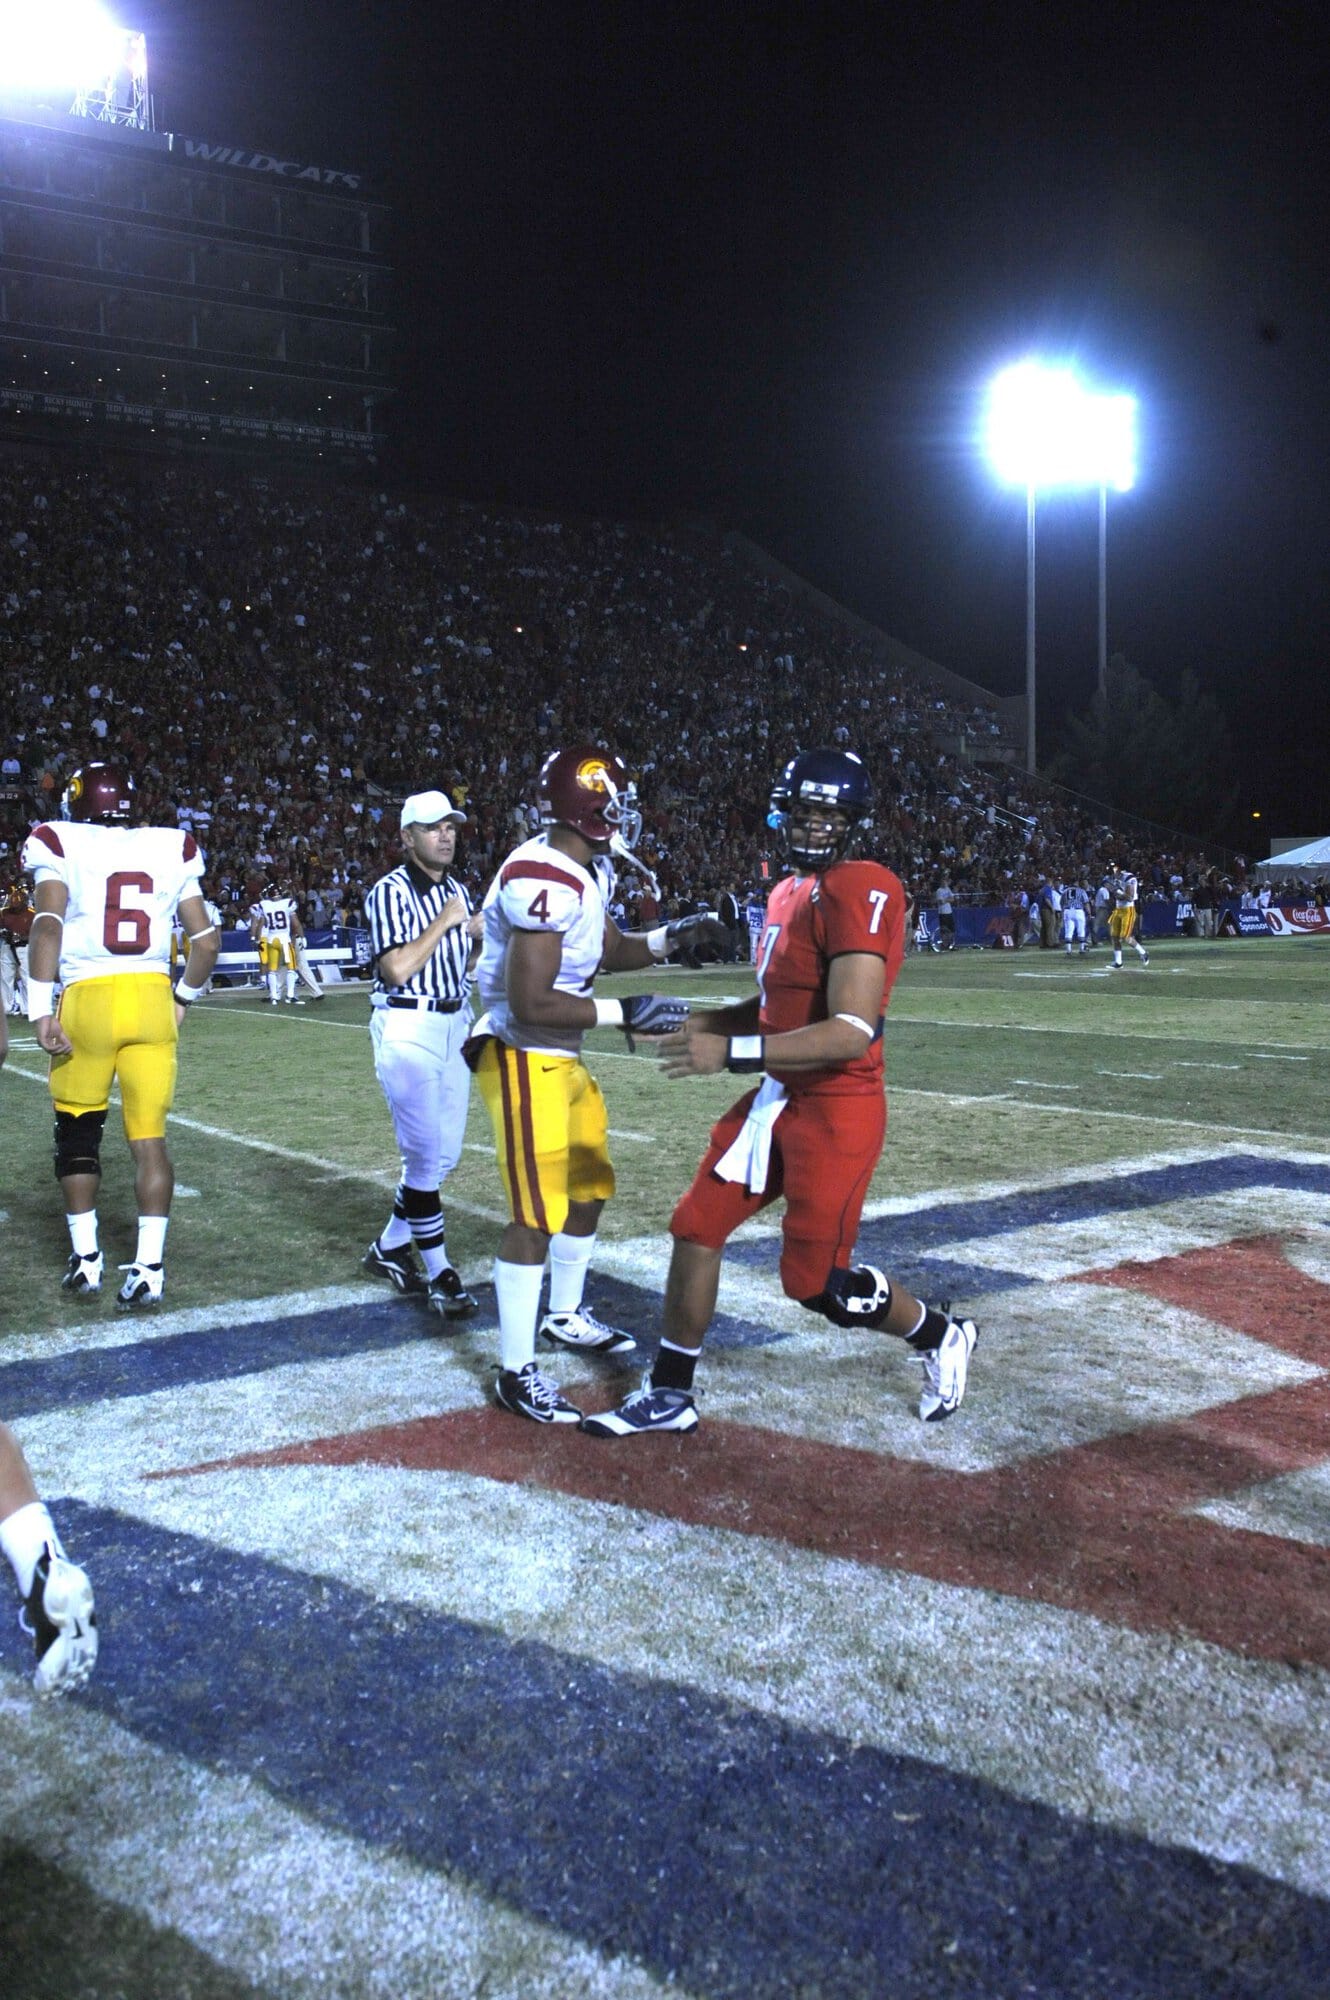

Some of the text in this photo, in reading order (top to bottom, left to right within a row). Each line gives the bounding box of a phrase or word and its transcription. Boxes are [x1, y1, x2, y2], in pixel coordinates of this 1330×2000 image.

[184, 139, 361, 189] WILDCATS
[103, 871, 154, 956] 6
[266, 910, 287, 930] 19
[527, 889, 551, 924] 4
[868, 888, 888, 934] 7
[1239, 914, 1260, 922] Game
[1239, 922, 1268, 932] Sponsor
[756, 924, 782, 1008] 7
